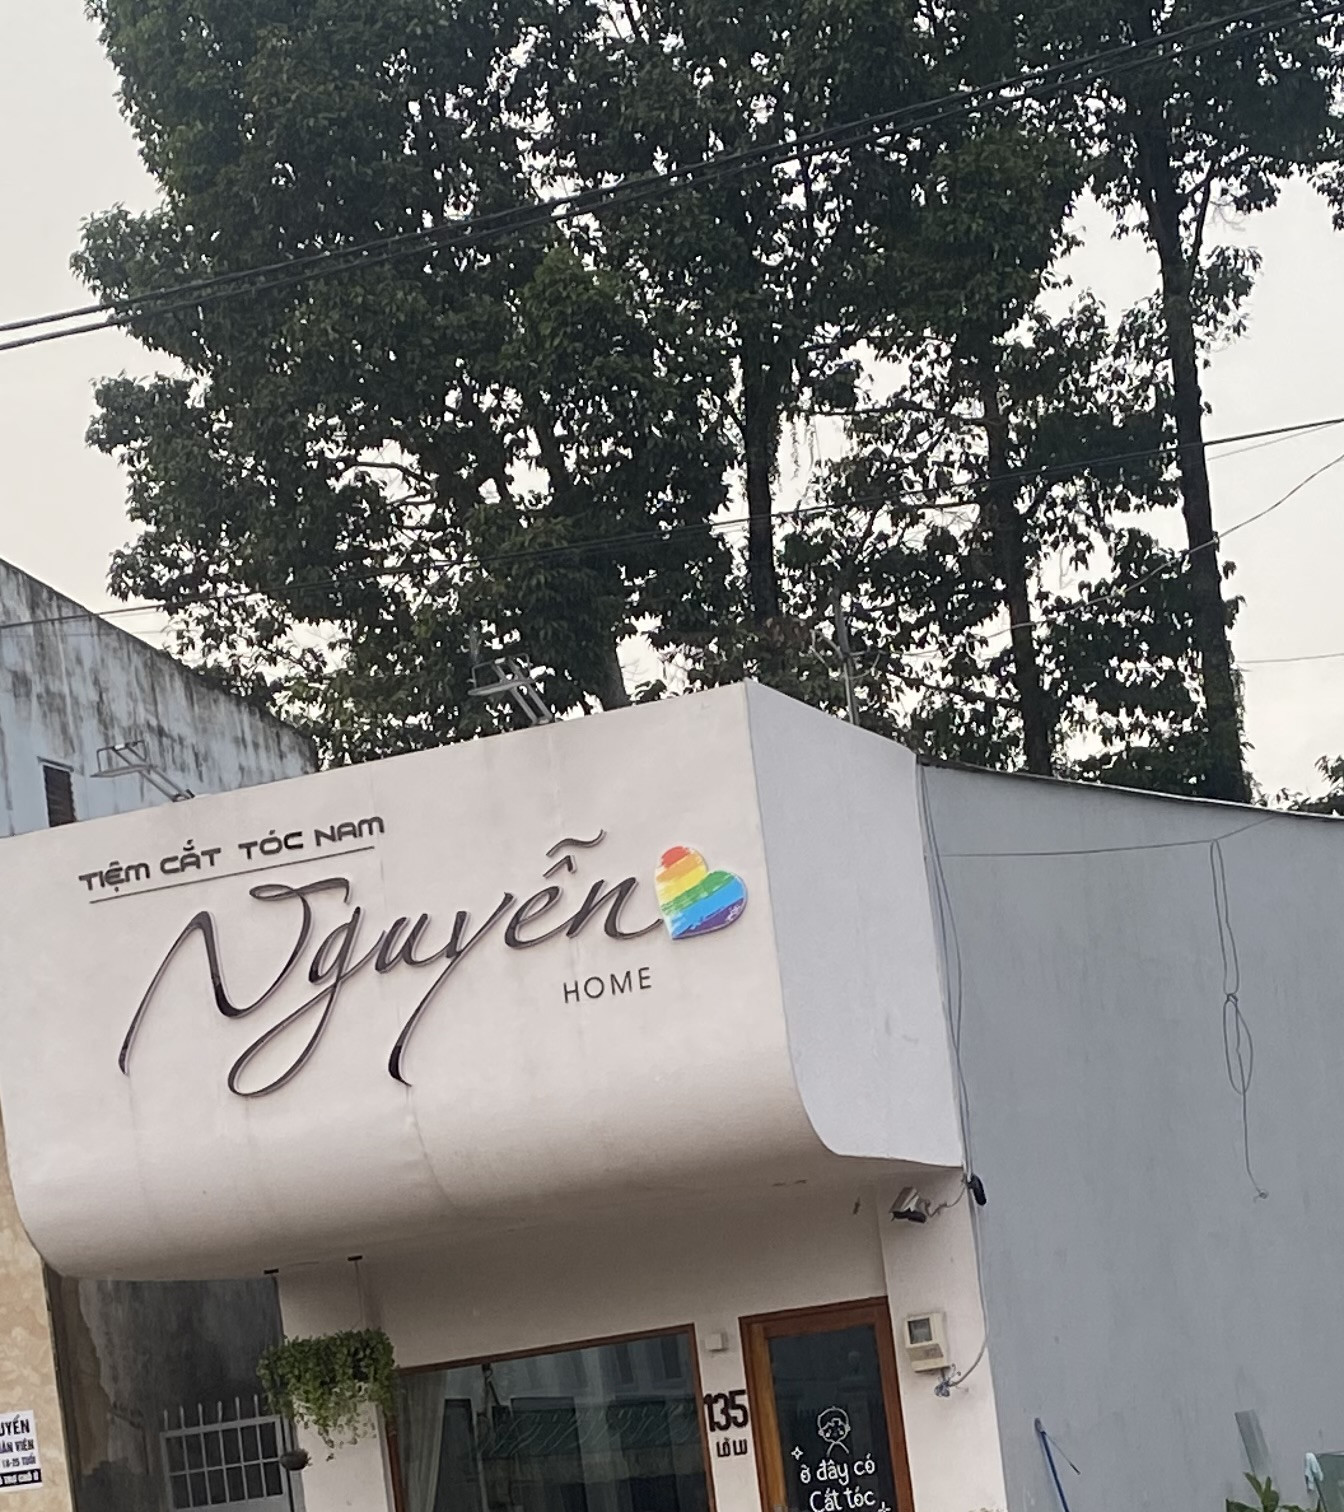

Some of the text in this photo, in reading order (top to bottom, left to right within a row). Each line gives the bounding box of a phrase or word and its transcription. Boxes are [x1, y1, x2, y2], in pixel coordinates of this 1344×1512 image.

[78, 815, 386, 892] TIỆM CẮT TÓC NAM
[117, 828, 664, 1097] Nguyễn
[562, 966, 654, 1004] HOME
[703, 1389, 749, 1432] 135
[816, 1459, 849, 1486] đây
[853, 1453, 875, 1476] có
[810, 1485, 876, 1512] Cắt tóc
